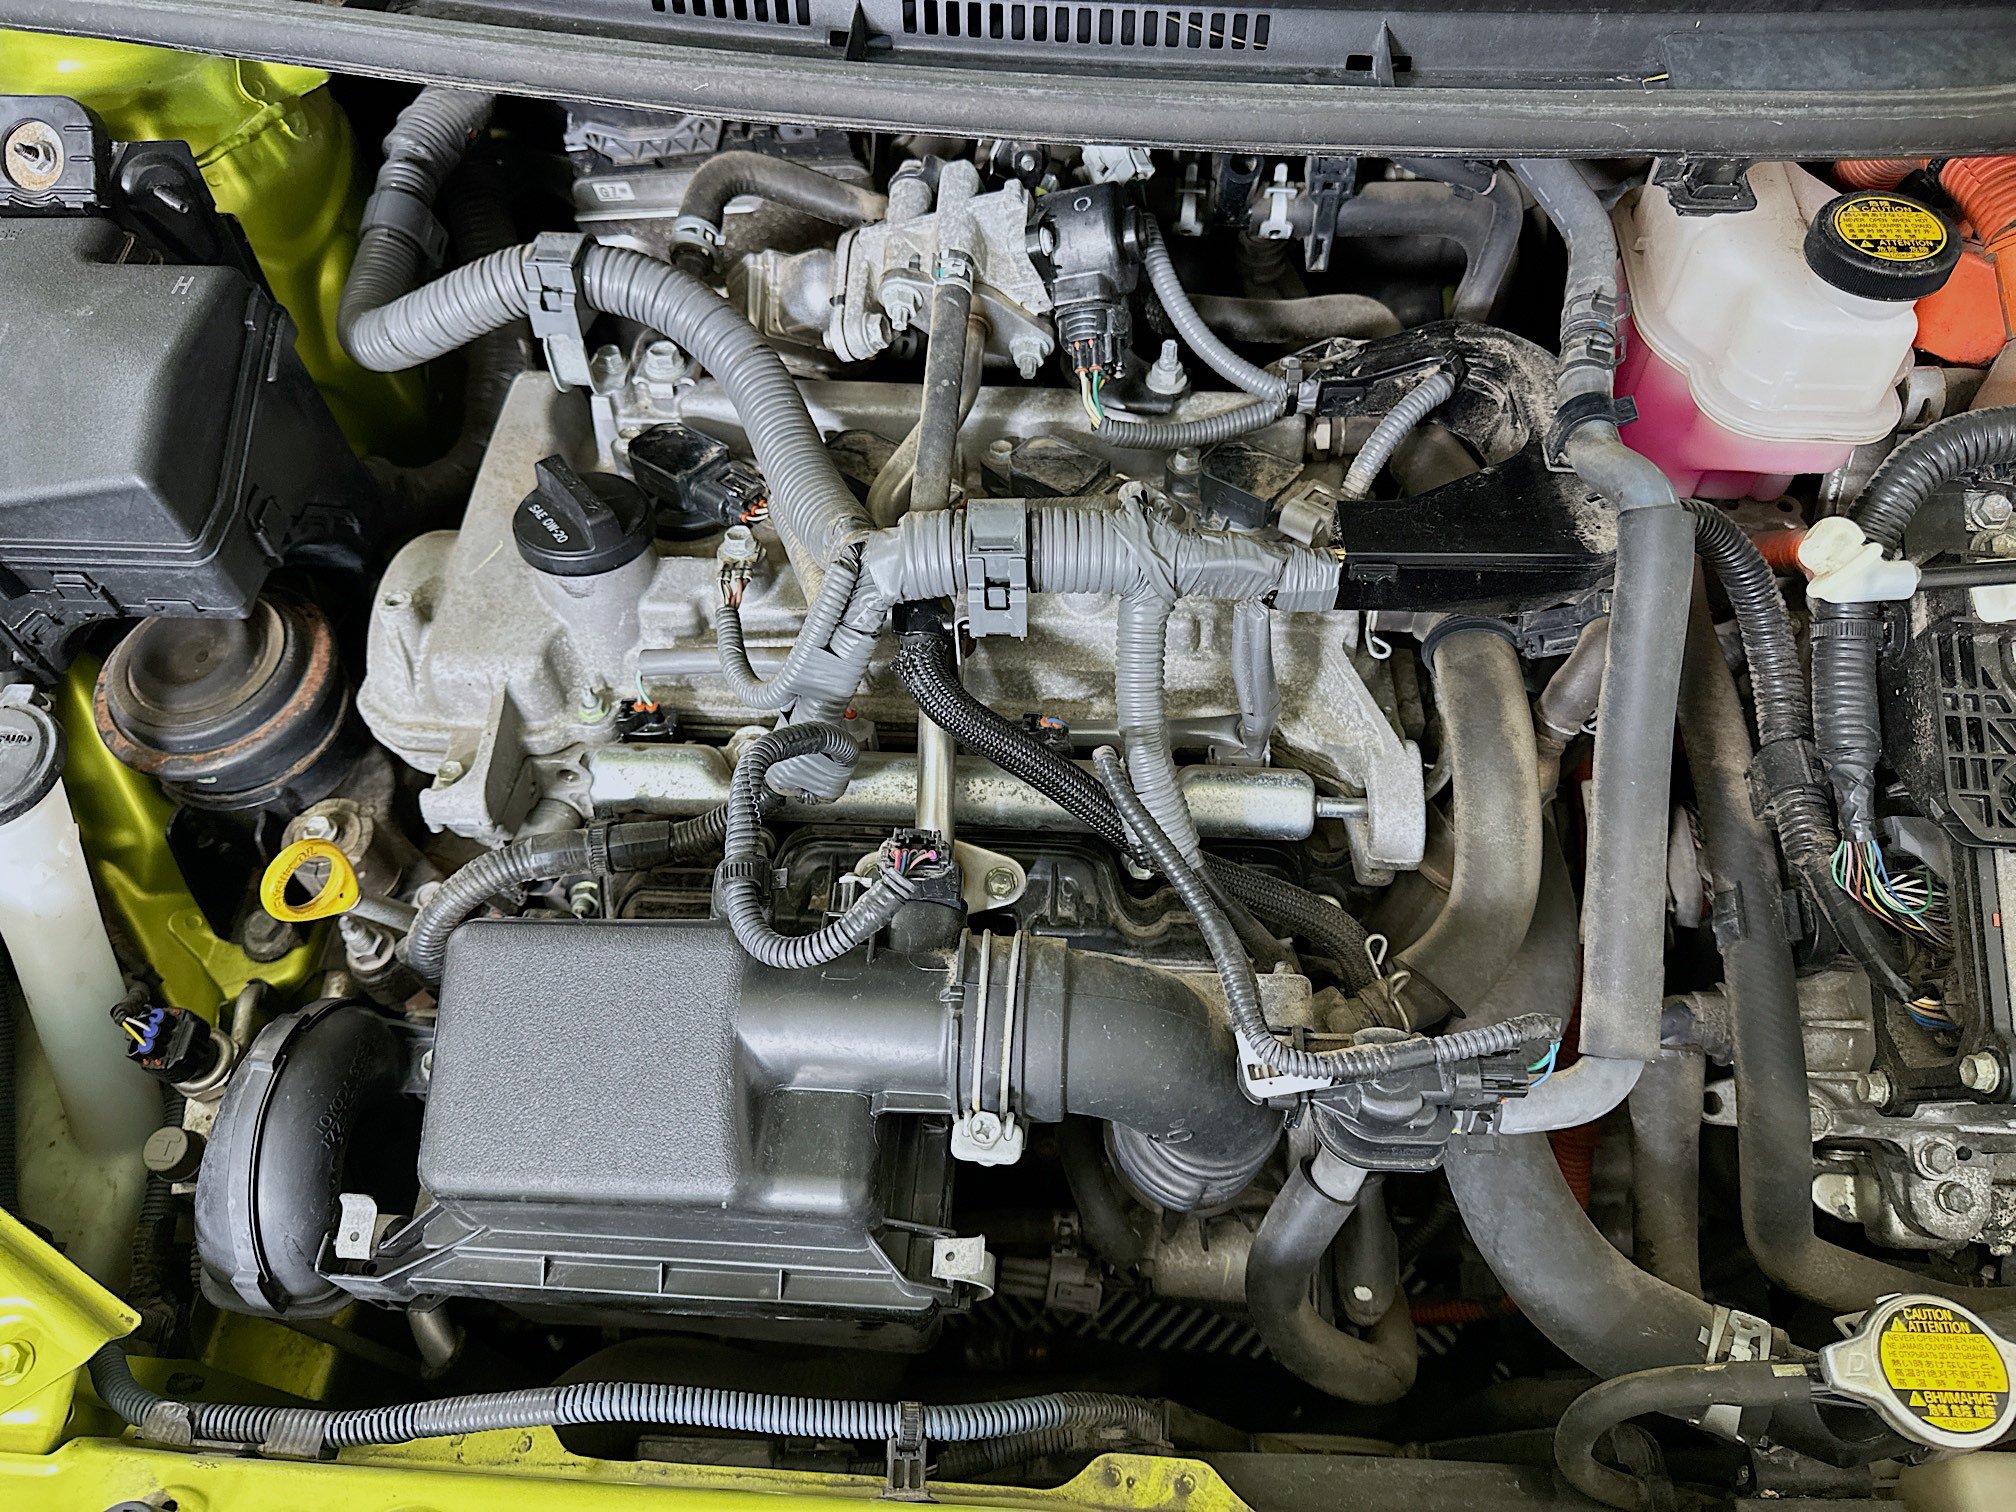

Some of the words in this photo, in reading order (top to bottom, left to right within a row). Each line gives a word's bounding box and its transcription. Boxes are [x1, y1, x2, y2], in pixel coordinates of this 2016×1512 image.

[171, 275, 195, 295] H
[527, 504, 548, 520] SAE
[542, 518, 568, 543] 0W-20
[298, 845, 318, 862] OIL
[1903, 1307, 1953, 1321] CAUTION
[1908, 1320, 1971, 1334] ATTENTION
[1923, 1390, 1998, 1405] ВНИМАНИЕ!
